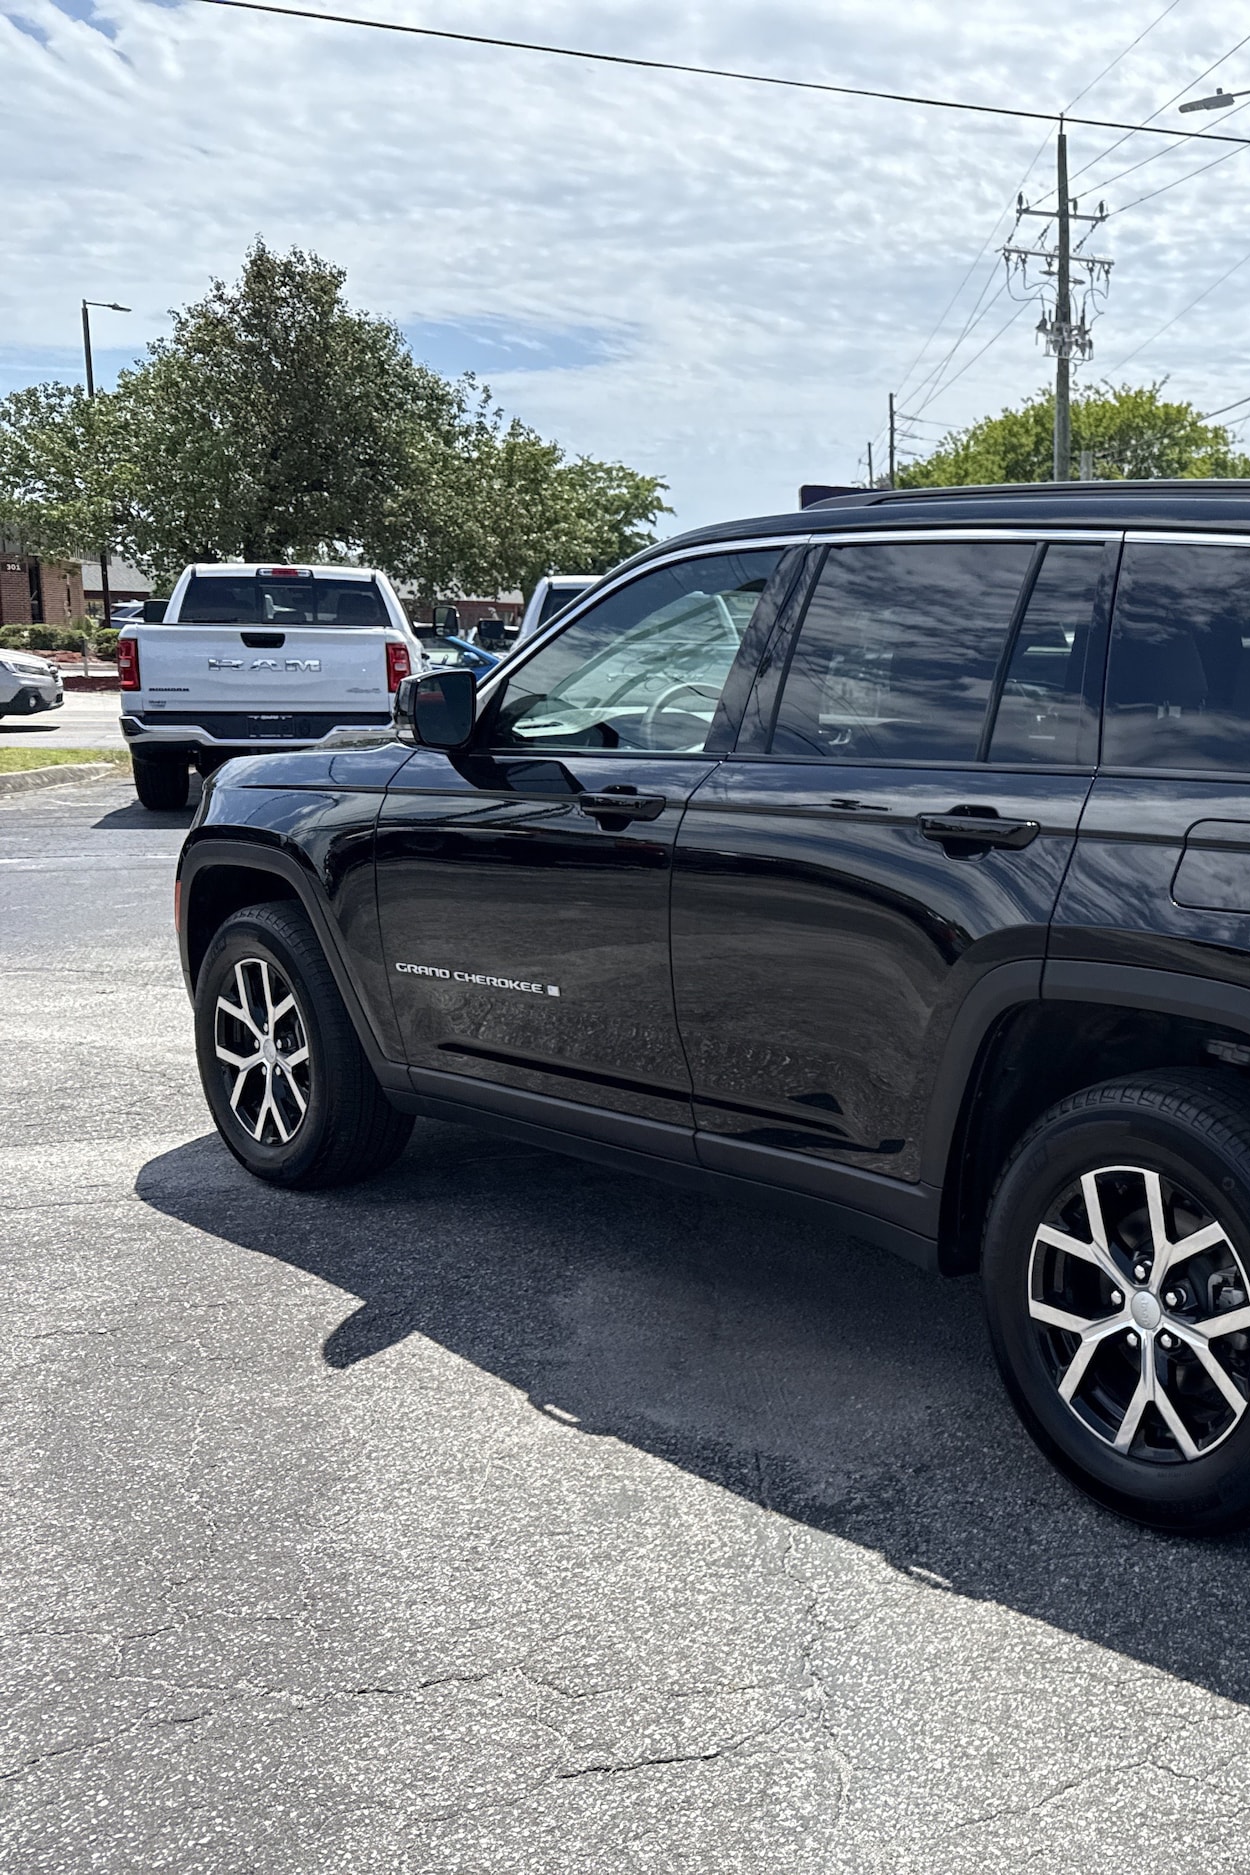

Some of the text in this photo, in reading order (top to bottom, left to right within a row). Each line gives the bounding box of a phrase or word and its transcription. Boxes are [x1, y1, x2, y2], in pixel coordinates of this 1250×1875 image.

[6, 563, 21, 571] 301
[208, 658, 322, 672] RAM
[395, 962, 544, 994] GRAND CHEROKEE
